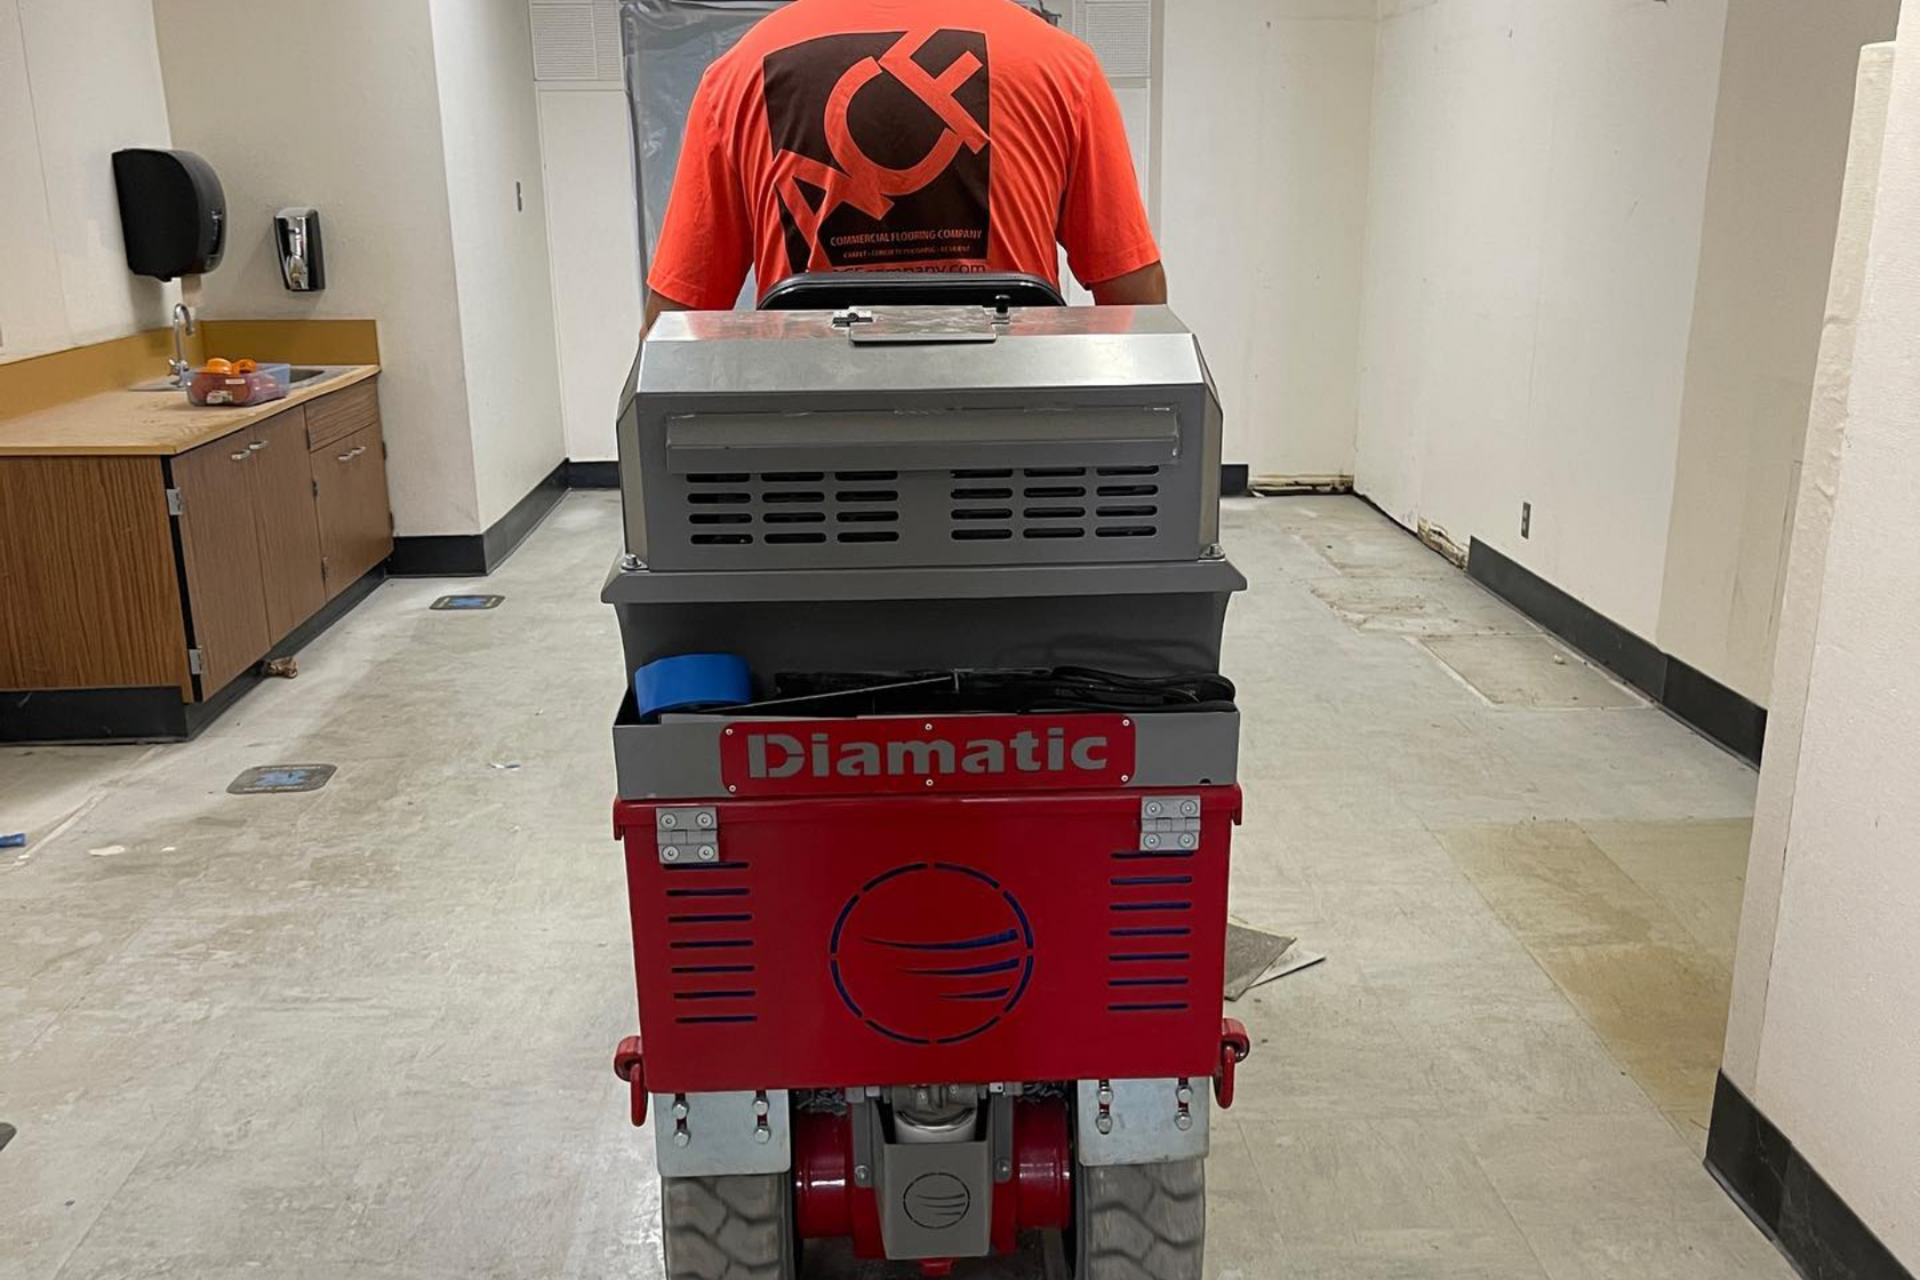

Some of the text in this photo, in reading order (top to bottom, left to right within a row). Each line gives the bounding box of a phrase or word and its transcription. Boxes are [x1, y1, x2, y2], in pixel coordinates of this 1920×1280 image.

[830, 228, 982, 247] COMMERCIAL FLOORING COMPANY
[748, 728, 1108, 778] Diamatic
